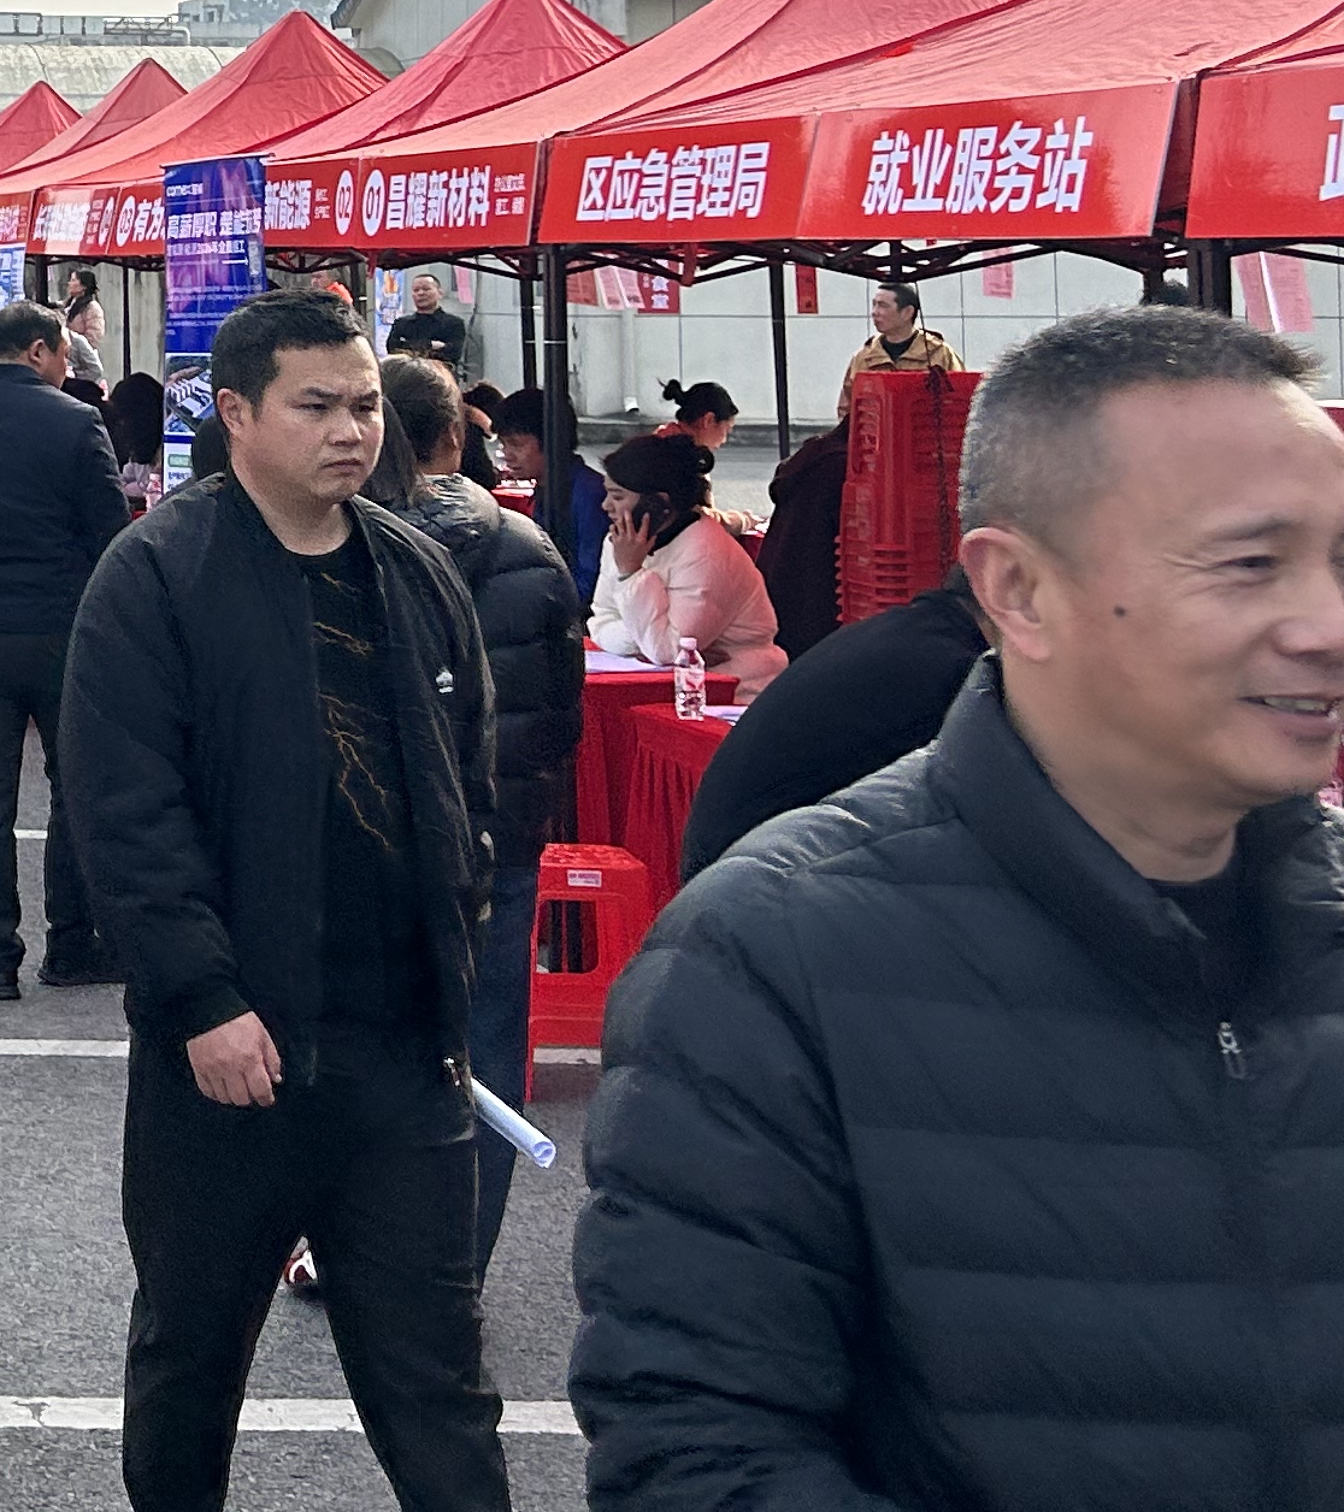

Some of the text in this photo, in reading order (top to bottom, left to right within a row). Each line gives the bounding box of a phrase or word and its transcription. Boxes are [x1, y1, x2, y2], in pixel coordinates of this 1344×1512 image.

[366, 185, 382, 221] 01
[385, 165, 491, 230] 昌耀新材料
[576, 141, 771, 223] 区应急管理局
[861, 115, 1094, 216] 就业服务站
[265, 180, 312, 231] 新能源
[337, 185, 352, 220] 02
